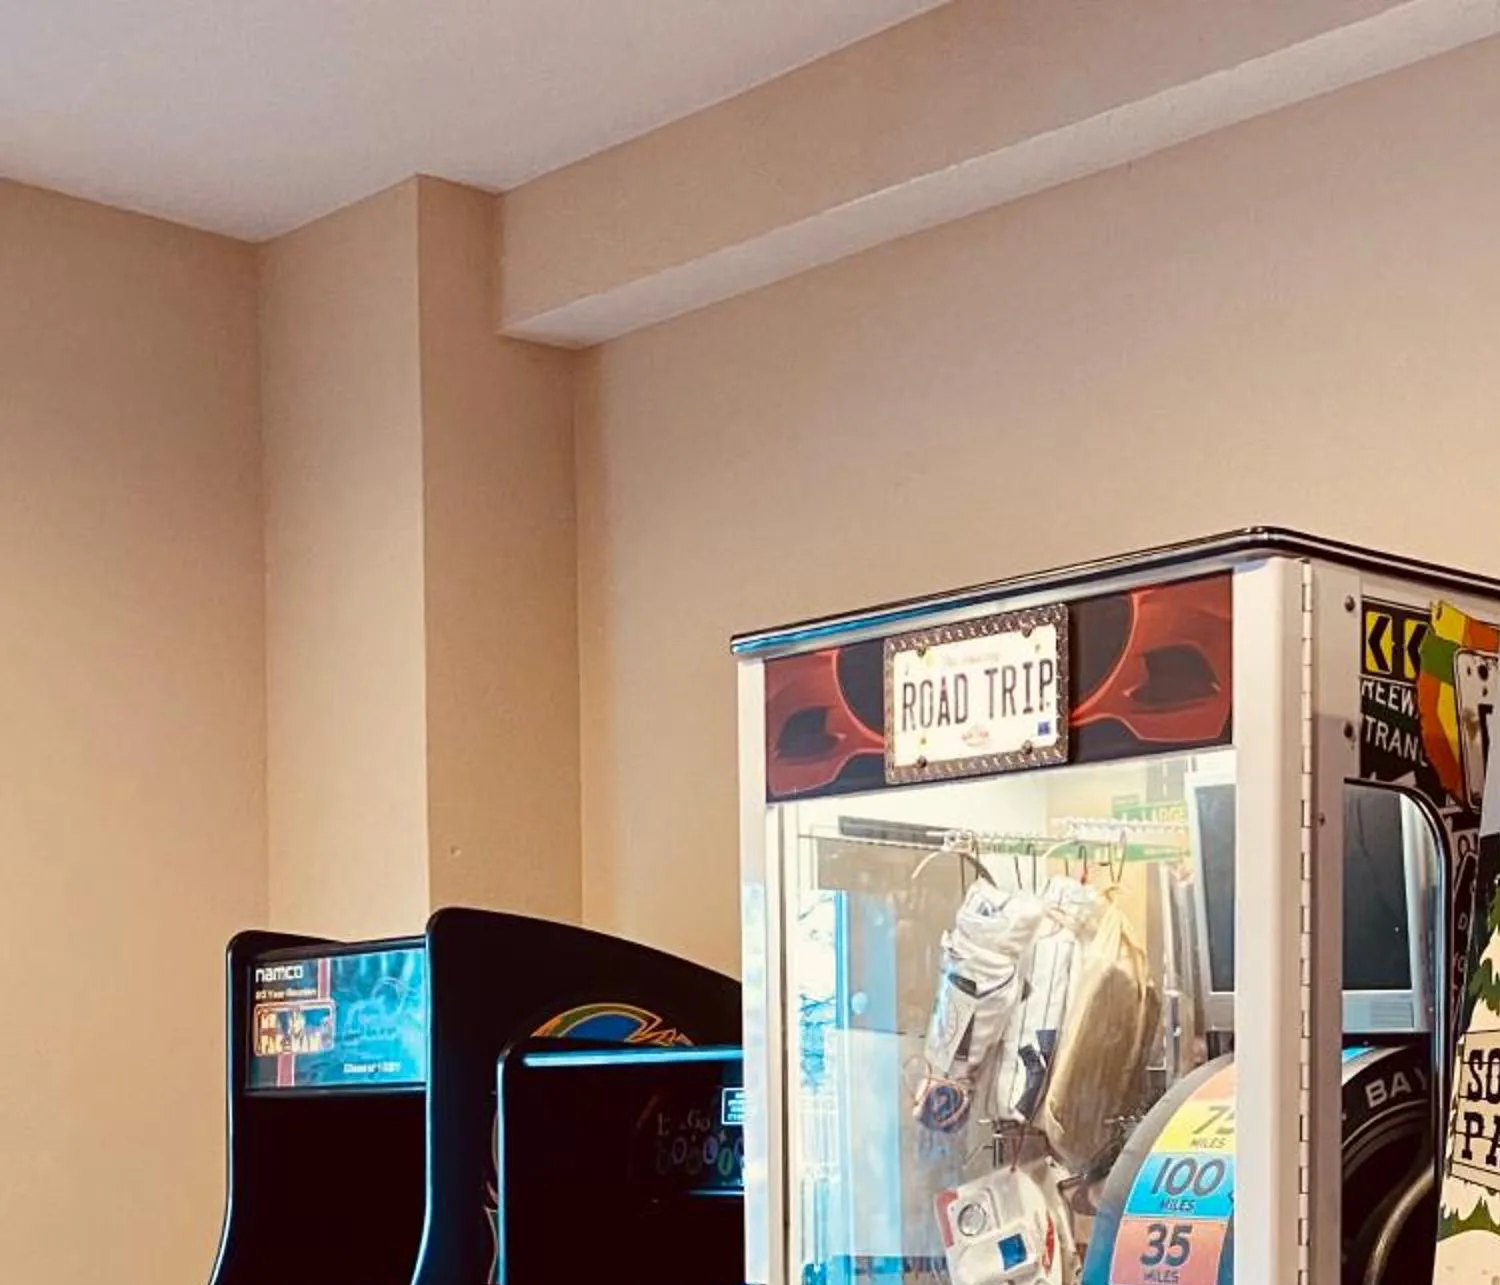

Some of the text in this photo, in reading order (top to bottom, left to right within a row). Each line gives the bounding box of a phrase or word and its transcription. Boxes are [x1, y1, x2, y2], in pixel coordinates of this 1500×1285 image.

[902, 659, 1054, 731] ROAD TRIP
[255, 965, 304, 983] namco
[1151, 1158, 1225, 1196] 100
[1159, 1197, 1195, 1212] MILES
[1140, 1223, 1193, 1268] 35
[1143, 1269, 1179, 1285] MILES
